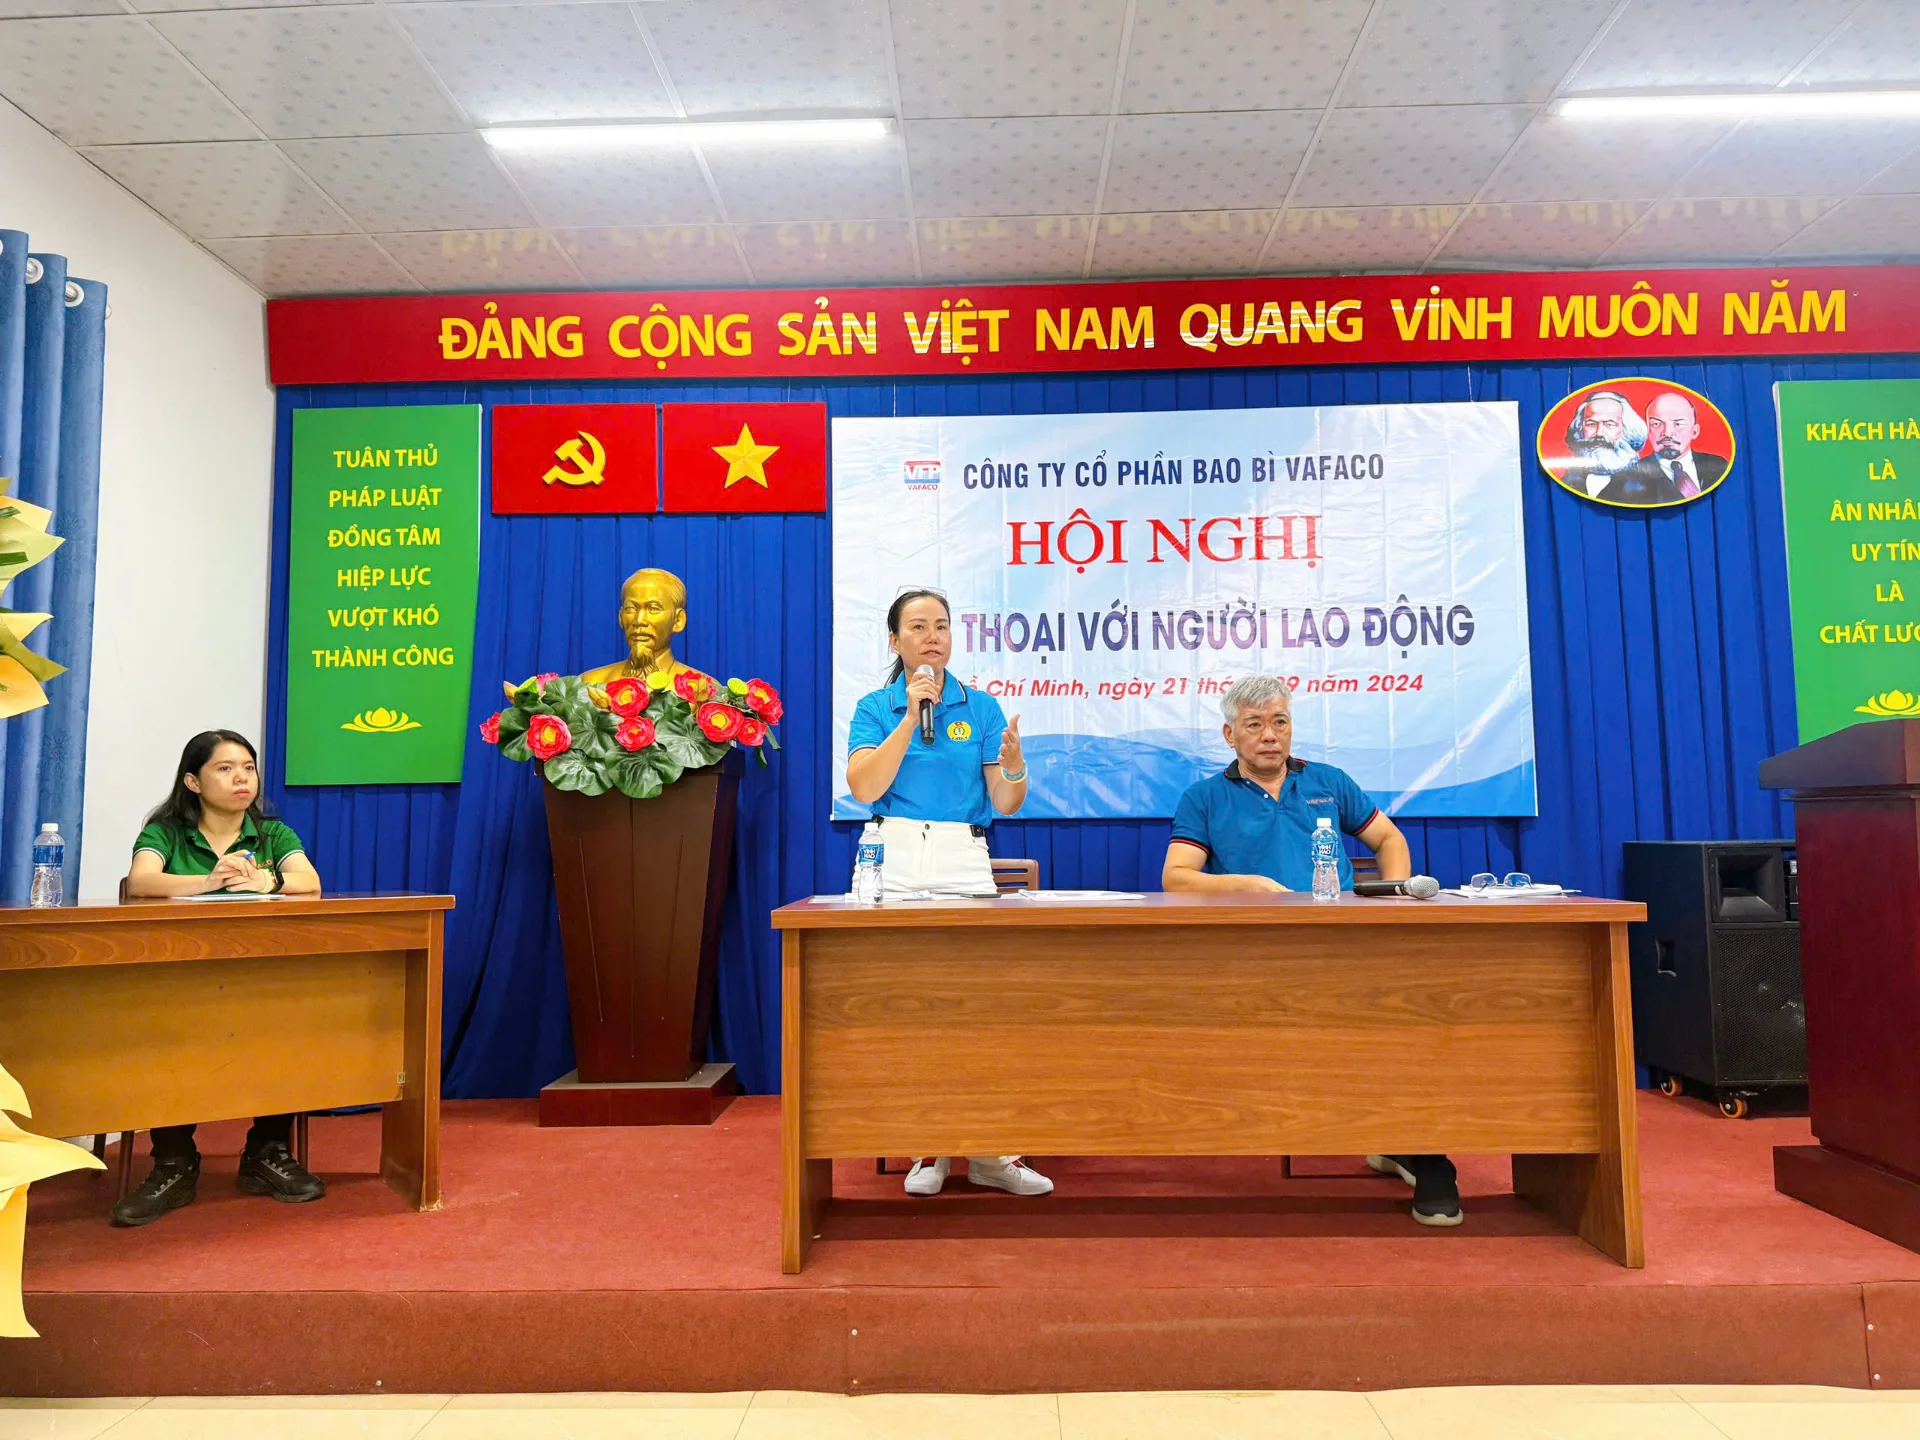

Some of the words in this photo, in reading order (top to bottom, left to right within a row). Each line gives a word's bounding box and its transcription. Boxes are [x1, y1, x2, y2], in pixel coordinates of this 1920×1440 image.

[438, 301, 583, 359] ĐẢNG
[608, 303, 752, 370] CỘNG
[778, 296, 877, 355] SẢN
[1036, 306, 1155, 352] NAM
[1179, 299, 1363, 353] QUANG
[1539, 281, 1698, 338] MUÔN
[1723, 279, 1846, 335] NĂM
[1806, 419, 1883, 441] KHÁCH
[333, 446, 390, 468] TUÂN
[395, 443, 438, 467] THỦ
[963, 457, 1029, 490] CÔNG
[1037, 462, 1066, 488] TY
[1075, 449, 1108, 487] CỔ
[1117, 450, 1182, 486] PHẦN
[1193, 457, 1242, 484] BAO
[1251, 450, 1276, 483] BÌ
[1285, 453, 1384, 482] VAFACO
[1869, 458, 1897, 480] LÀ
[329, 486, 386, 508] PHÁP
[391, 485, 442, 510] LUẬT
[1830, 499, 1862, 521] ÂN
[1868, 498, 1920, 521] NHÂ
[327, 524, 392, 548] ĐỒNG
[395, 524, 441, 546] TÂM
[1007, 507, 1128, 574] HỘI
[1147, 514, 1323, 568] NGHỊ
[1851, 543, 1882, 562] UY
[1886, 539, 1920, 561] TÍN
[337, 565, 385, 592] HIỆP
[390, 565, 431, 591] LỰC
[1876, 580, 1904, 602] LÀ
[328, 607, 387, 631] VƯỢT
[393, 604, 439, 627] KHÓ
[961, 612, 1066, 665] THOẠI
[1078, 598, 1139, 651] VỚI
[1151, 597, 1268, 651] NGƯỜI
[1281, 607, 1350, 648] LAO
[1362, 594, 1475, 659] ĐỘNG
[1820, 619, 1879, 644] CHẤT
[312, 646, 387, 667] THÀNH
[392, 644, 454, 666] CÔNG
[986, 678, 1026, 697] Chí
[1030, 679, 1090, 698] Minh,
[1098, 676, 1156, 700] ngày
[1162, 677, 1187, 695] 21
[1197, 675, 1234, 695] thá
[1307, 675, 1359, 693] năm
[1366, 674, 1424, 693] 2024
